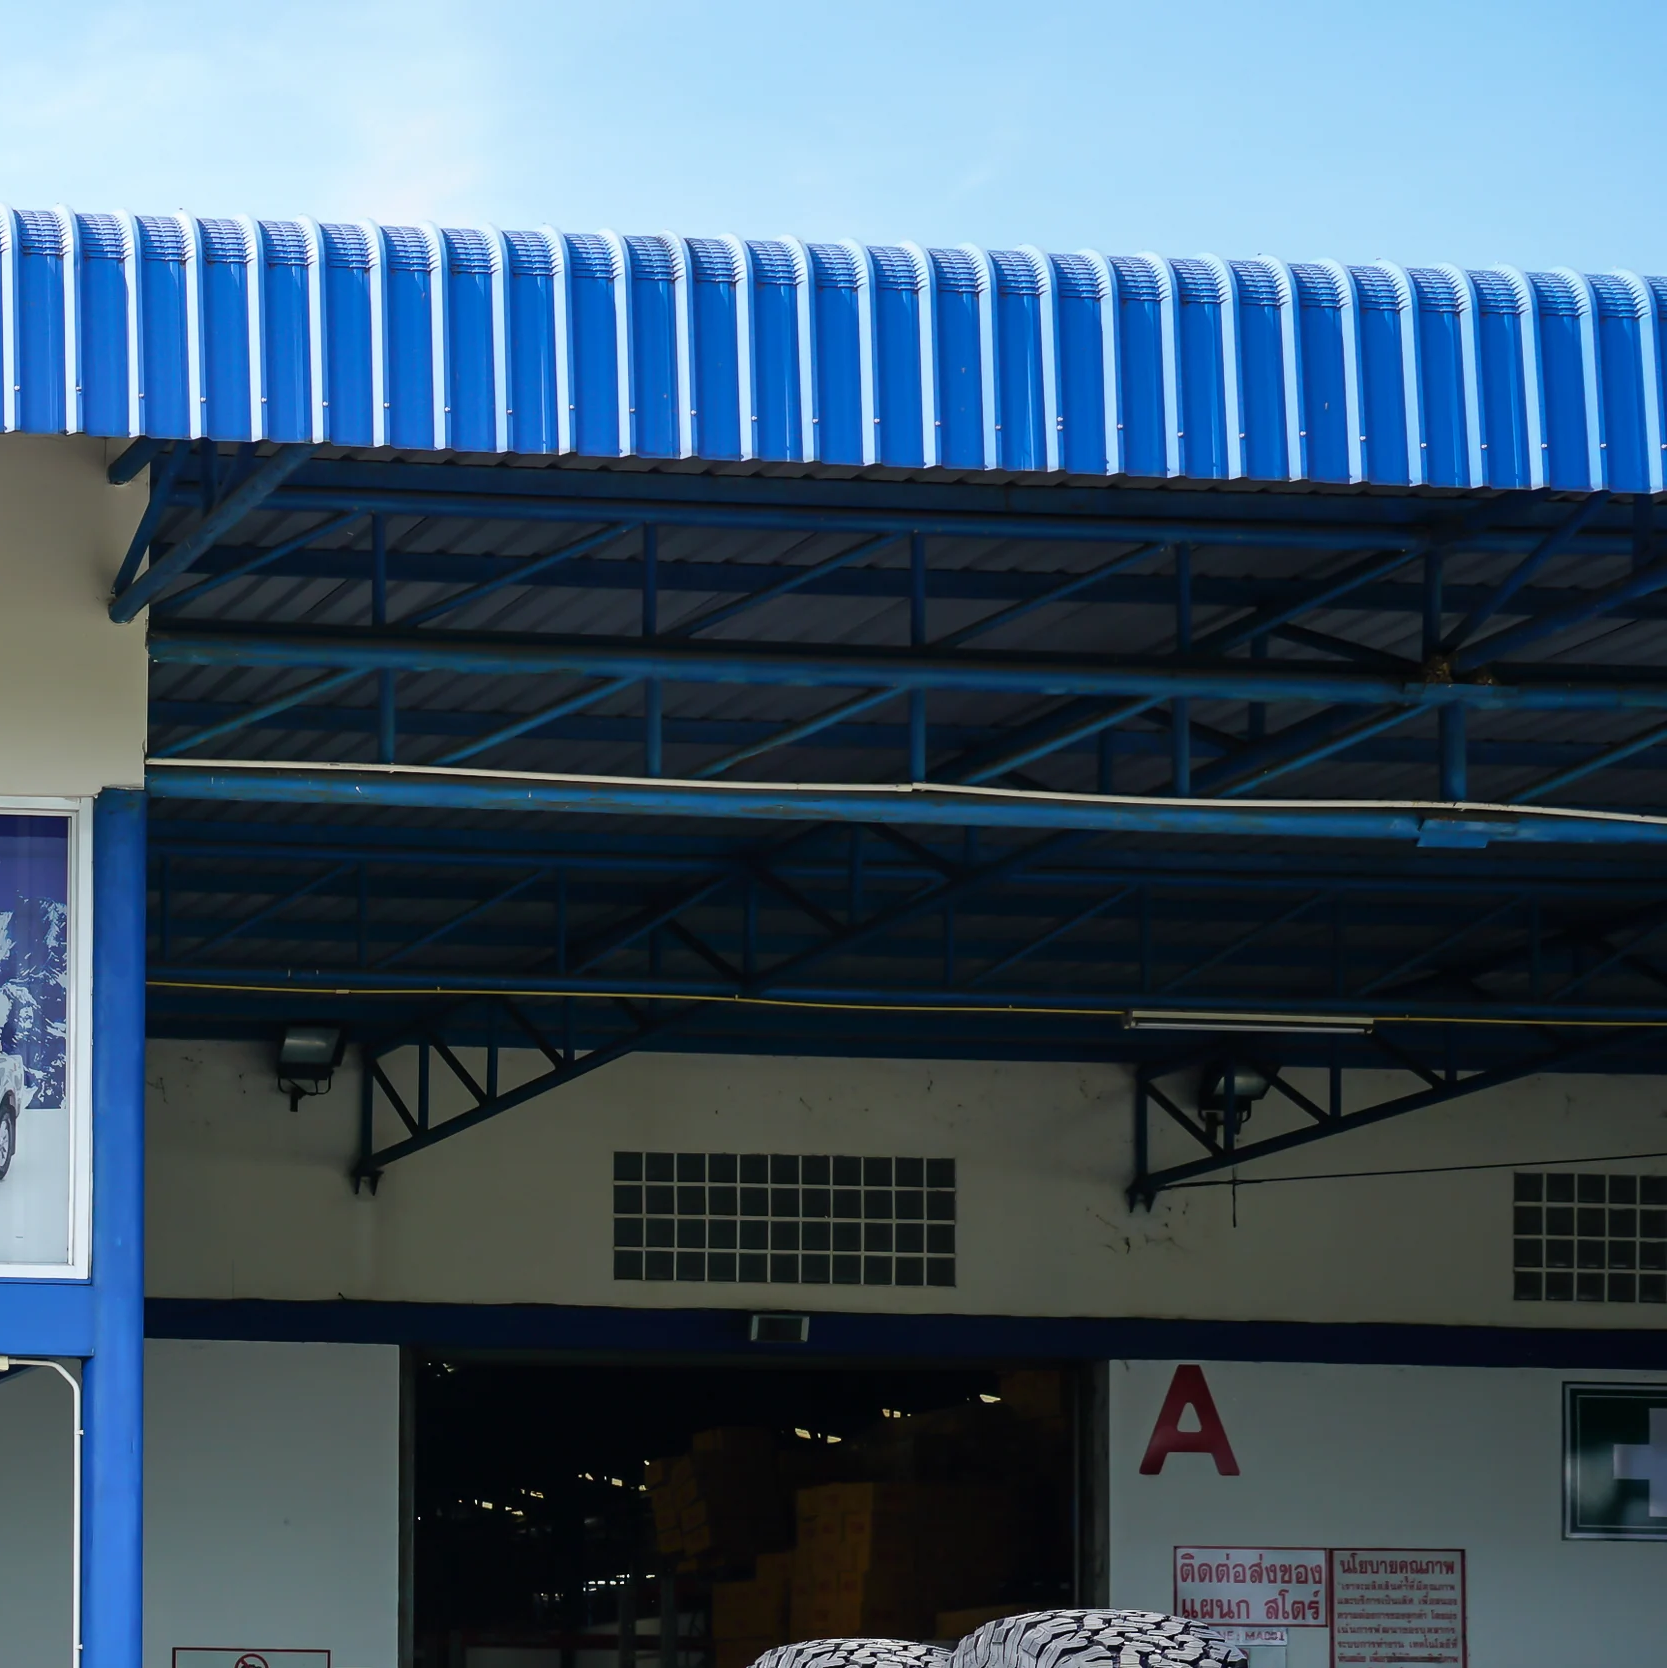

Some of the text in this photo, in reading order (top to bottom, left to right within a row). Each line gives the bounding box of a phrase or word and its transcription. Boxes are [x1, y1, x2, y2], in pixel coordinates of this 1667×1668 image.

[1139, 1364, 1241, 1477] A
[1180, 1552, 1323, 1584] ติดต่อส่งของ
[1181, 1597, 1250, 1620] แผนก
[1263, 1588, 1321, 1621] สโตร์
